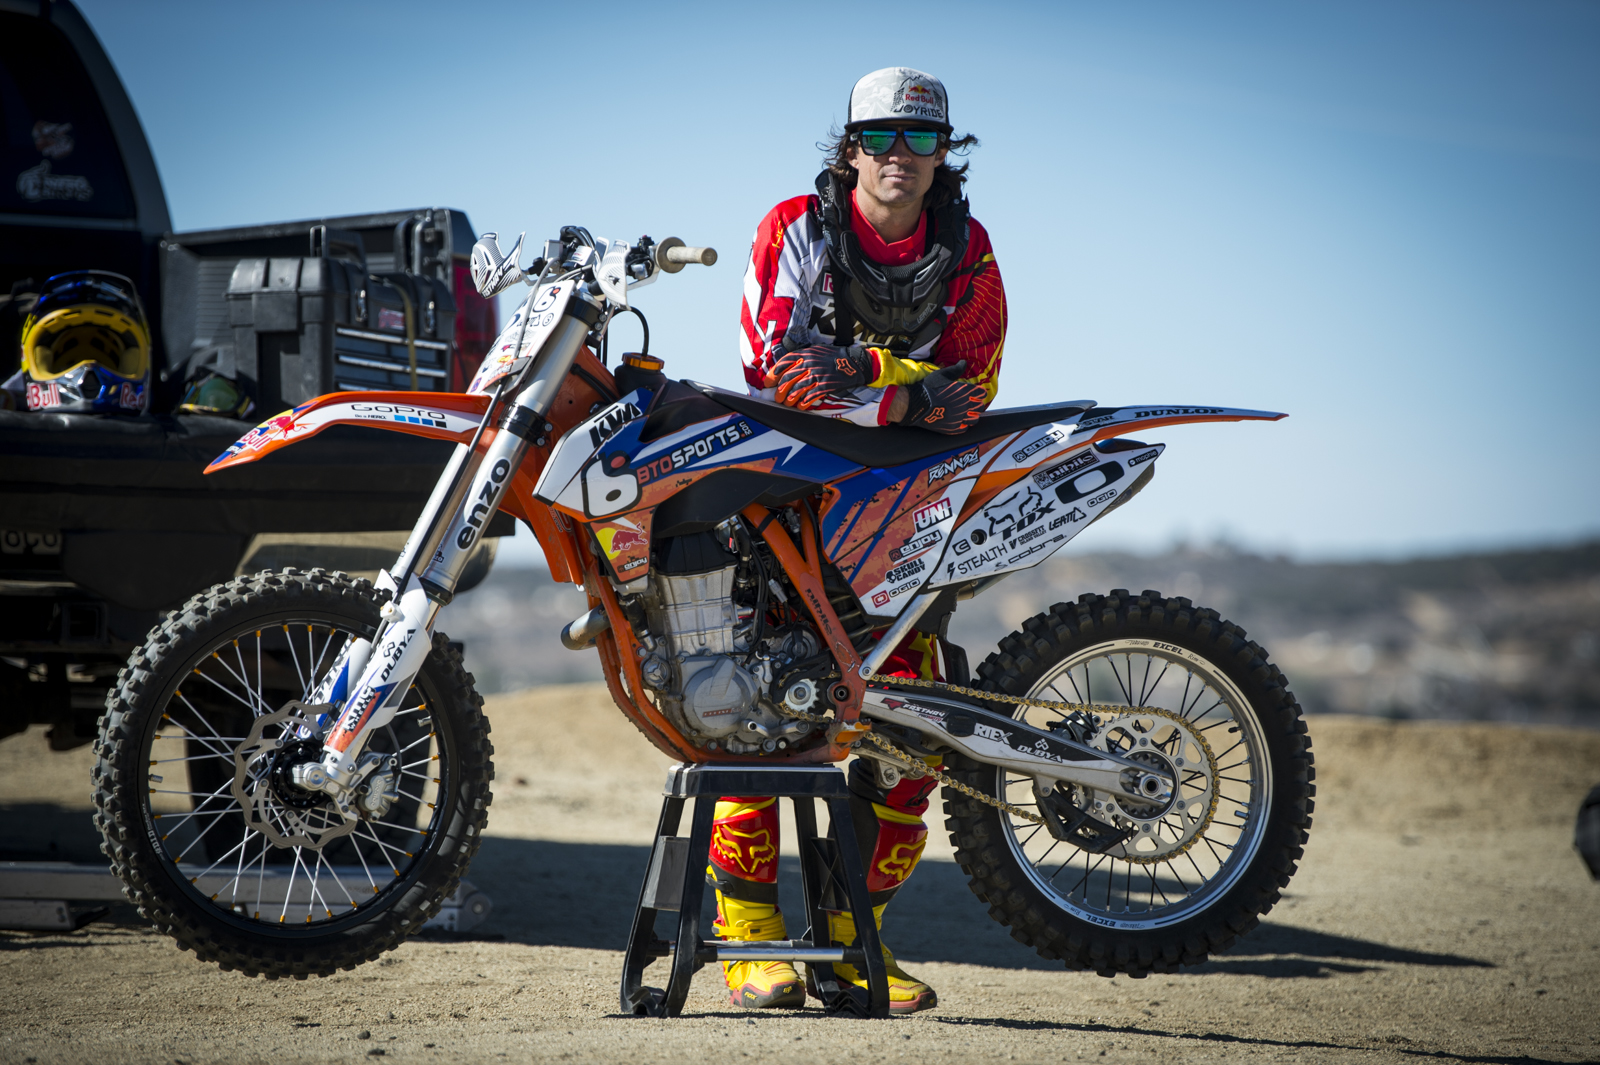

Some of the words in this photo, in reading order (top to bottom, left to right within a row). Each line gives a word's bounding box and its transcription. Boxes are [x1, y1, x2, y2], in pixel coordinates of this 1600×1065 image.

[905, 93, 920, 102] Red
[920, 94, 934, 104] Bull
[893, 104, 944, 118] JOYRIDE
[32, 384, 60, 408] Bull
[351, 404, 446, 420] GoPro
[1134, 408, 1224, 418] DUNLOP
[588, 402, 643, 449] KTM
[241, 429, 272, 449] Bull
[1049, 455, 1093, 478] nihilo
[1135, 450, 1158, 464] mophie
[581, 451, 642, 521] 6
[457, 458, 511, 550] enzo
[1087, 489, 1117, 508] OGIO
[914, 497, 953, 533] UNI
[1002, 499, 1056, 541] FOX
[1018, 525, 1045, 541] CROSSFIT
[901, 531, 942, 557] enjoy
[1008, 534, 1065, 564] cobra
[894, 558, 925, 577] SKULL
[957, 543, 1008, 574] STEALTH
[896, 563, 926, 582] CANDY
[889, 578, 920, 597] OGIO
[380, 628, 417, 682] DUBYA
[1153, 642, 1183, 655] EXCEL
[903, 703, 946, 717] FASTWAY
[1017, 744, 1063, 763] DUBYA
[1086, 913, 1116, 927] EXCEL
